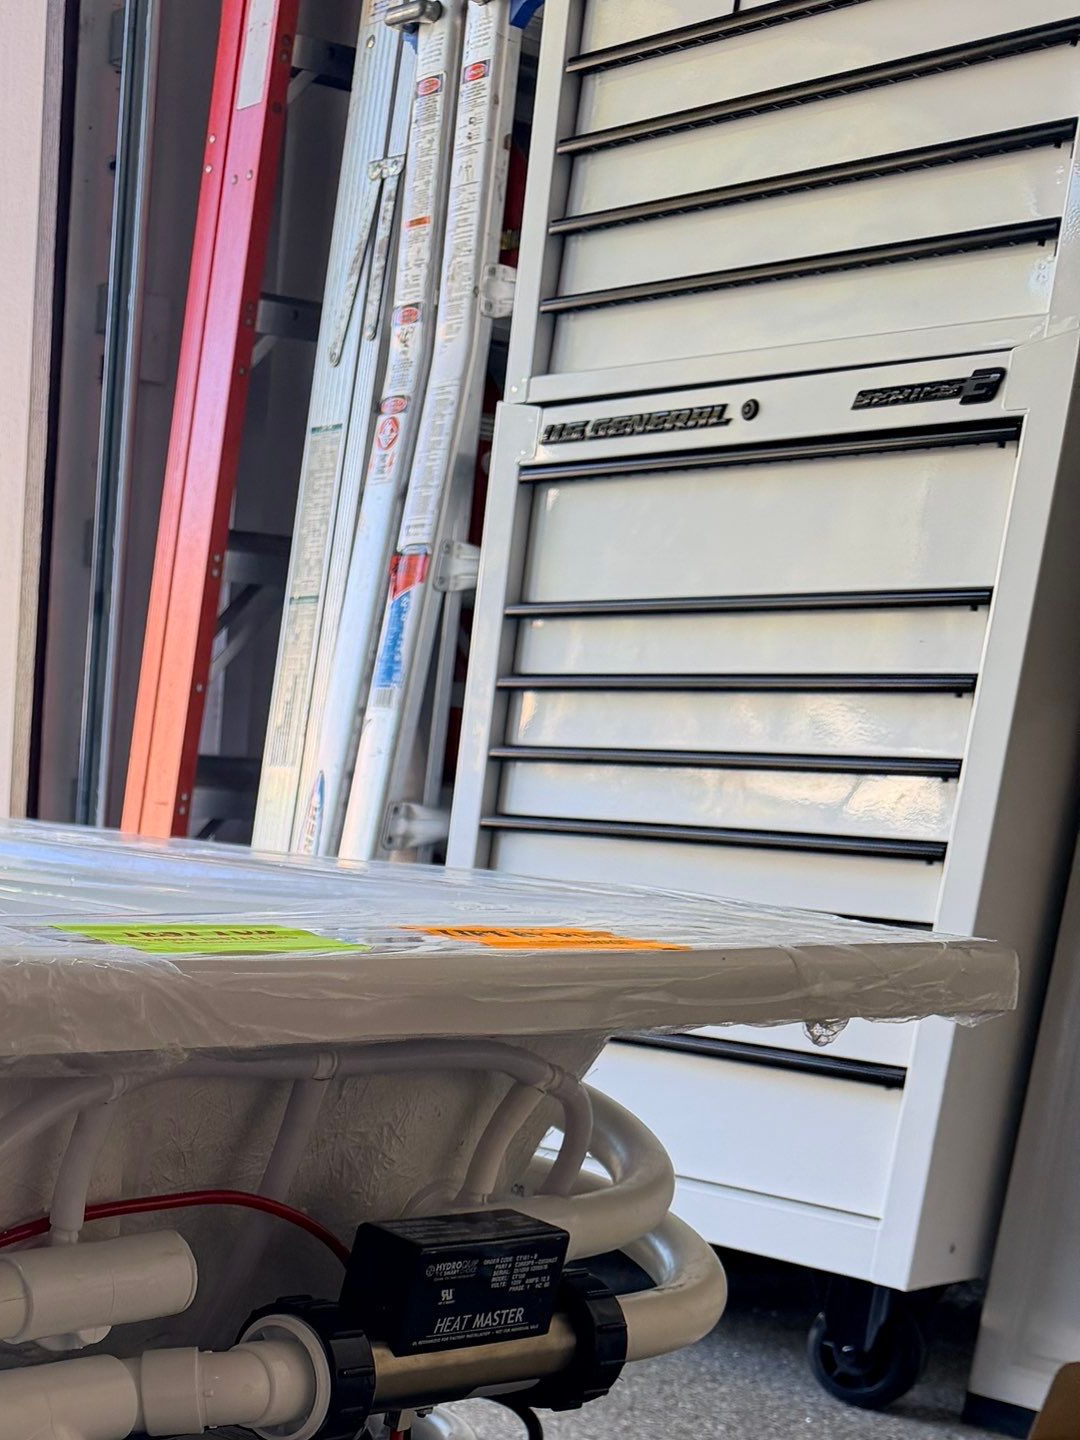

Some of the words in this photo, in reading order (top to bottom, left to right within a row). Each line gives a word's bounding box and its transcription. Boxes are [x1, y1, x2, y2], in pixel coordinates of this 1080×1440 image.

[587, 404, 733, 440] GENERAL
[433, 1314, 473, 1334] HEAT
[472, 1307, 525, 1329] MASTER
